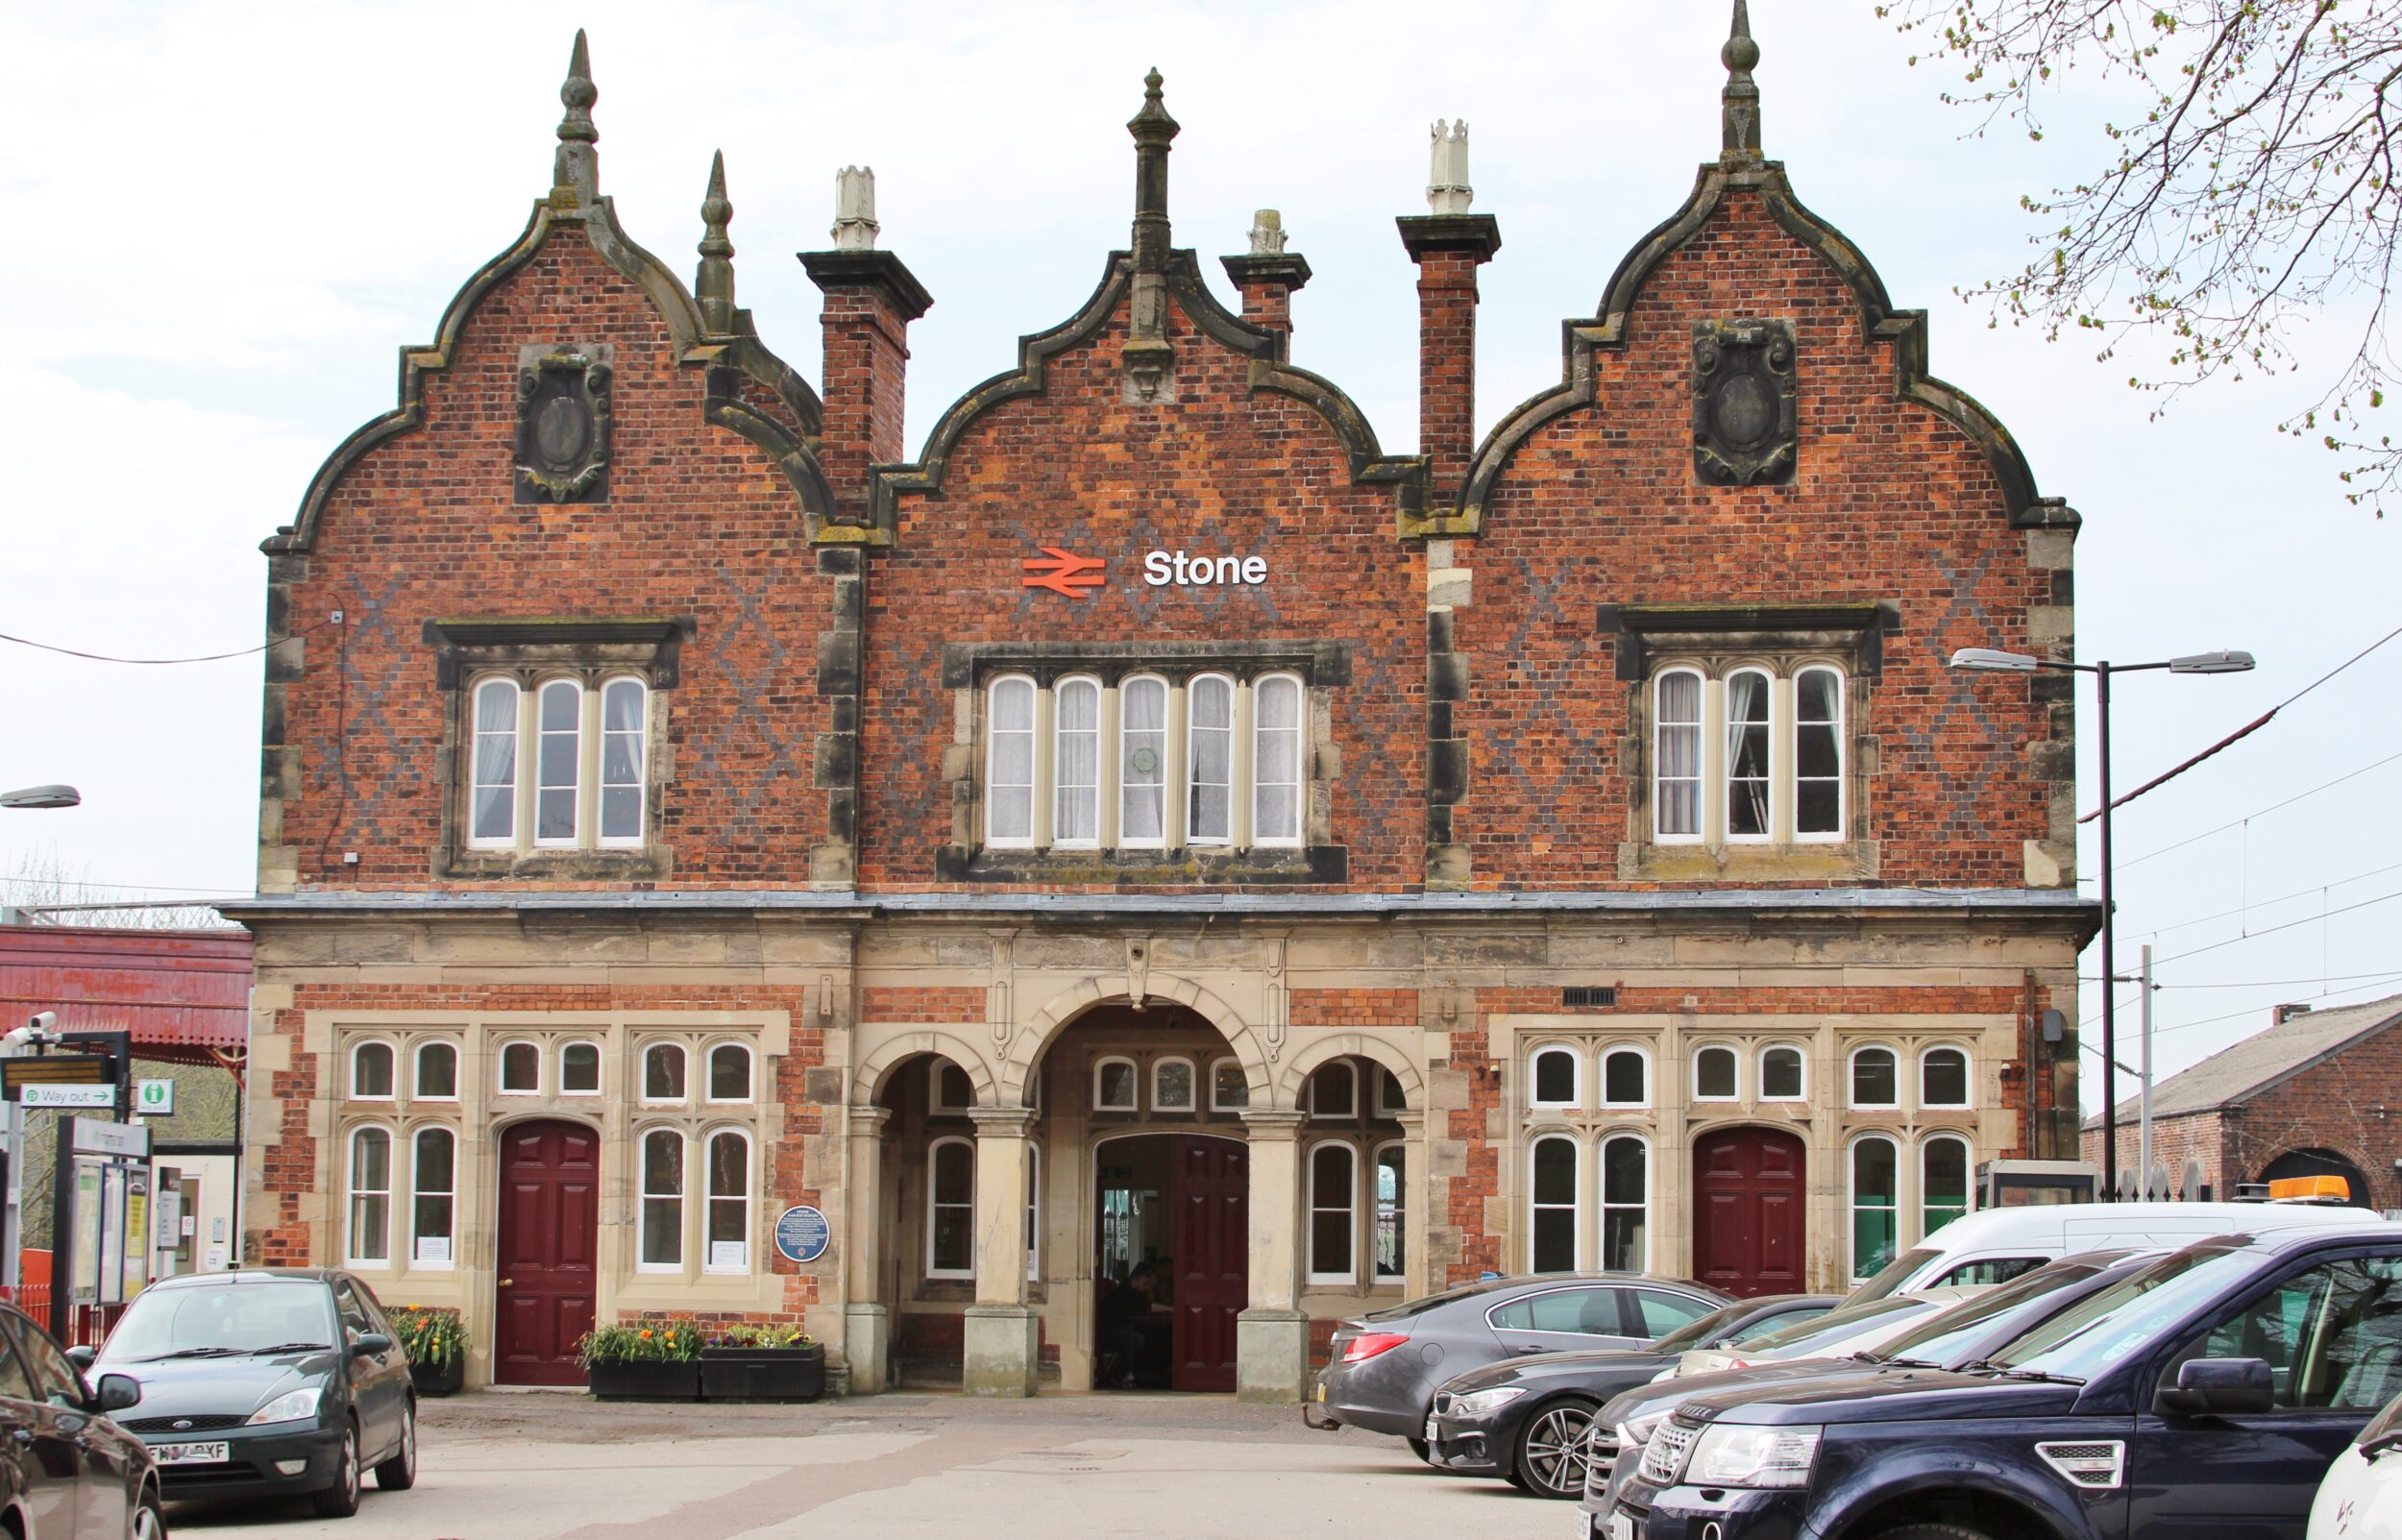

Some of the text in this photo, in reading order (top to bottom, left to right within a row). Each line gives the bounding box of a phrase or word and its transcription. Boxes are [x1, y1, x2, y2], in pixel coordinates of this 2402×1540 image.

[1143, 550, 1267, 586] Stone
[42, 1090, 88, 1104] Way out
